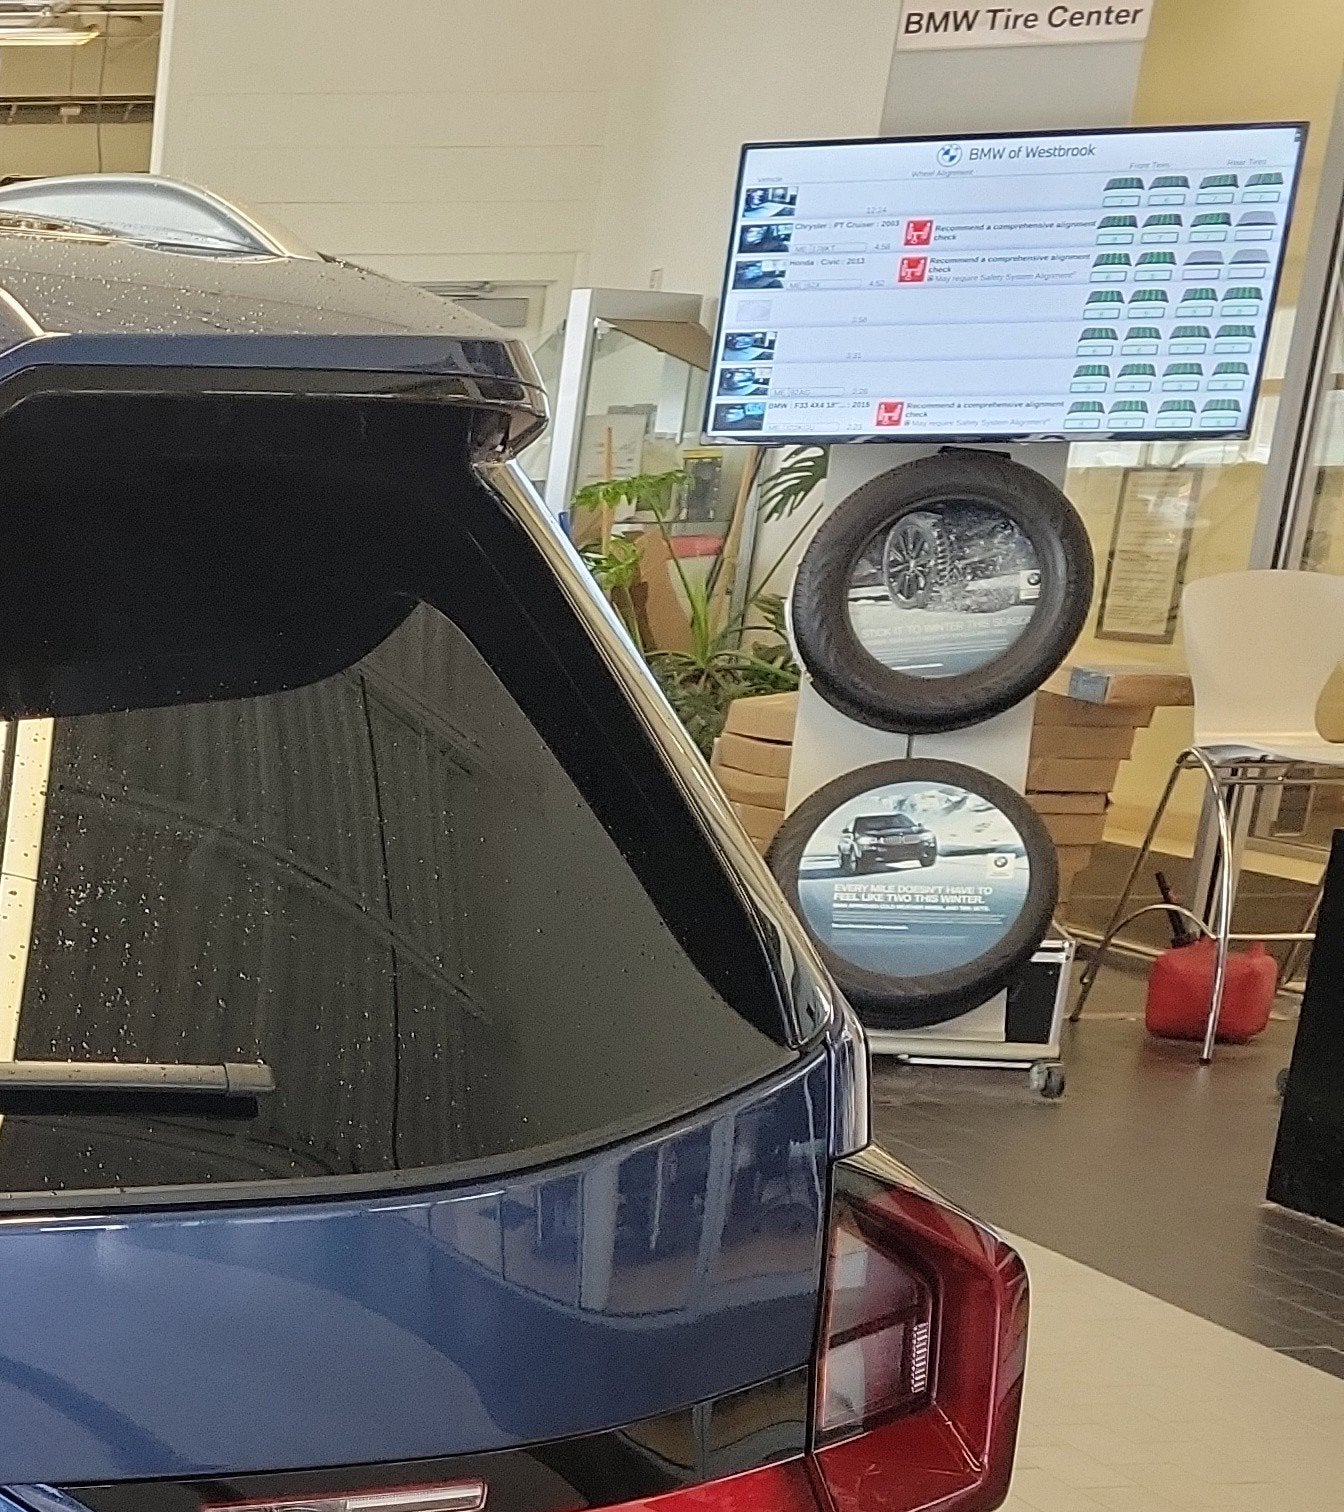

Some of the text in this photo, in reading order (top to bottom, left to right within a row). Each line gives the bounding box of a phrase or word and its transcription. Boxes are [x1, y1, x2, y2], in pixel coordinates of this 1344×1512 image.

[904, 5, 1144, 35] BMW Tire Center
[969, 144, 1097, 161] BMW of Westbrook
[795, 222, 827, 231] Chrysler
[935, 224, 984, 232] Recommend
[993, 222, 1053, 232] comprehensive
[1055, 220, 1096, 229] alignment
[933, 233, 957, 241] check
[789, 258, 814, 266] Honda
[987, 255, 1049, 263] comprehensive
[1050, 254, 1091, 262] alignment
[963, 401, 1024, 409] comprehensive
[1025, 400, 1064, 408] alignment
[834, 884, 993, 895] EVERY MILE DOESN'T HAVE TO
[834, 892, 860, 901] FEEL
[861, 893, 885, 902] LIKE
[887, 893, 912, 902] TWO
[914, 894, 939, 903] THIS
